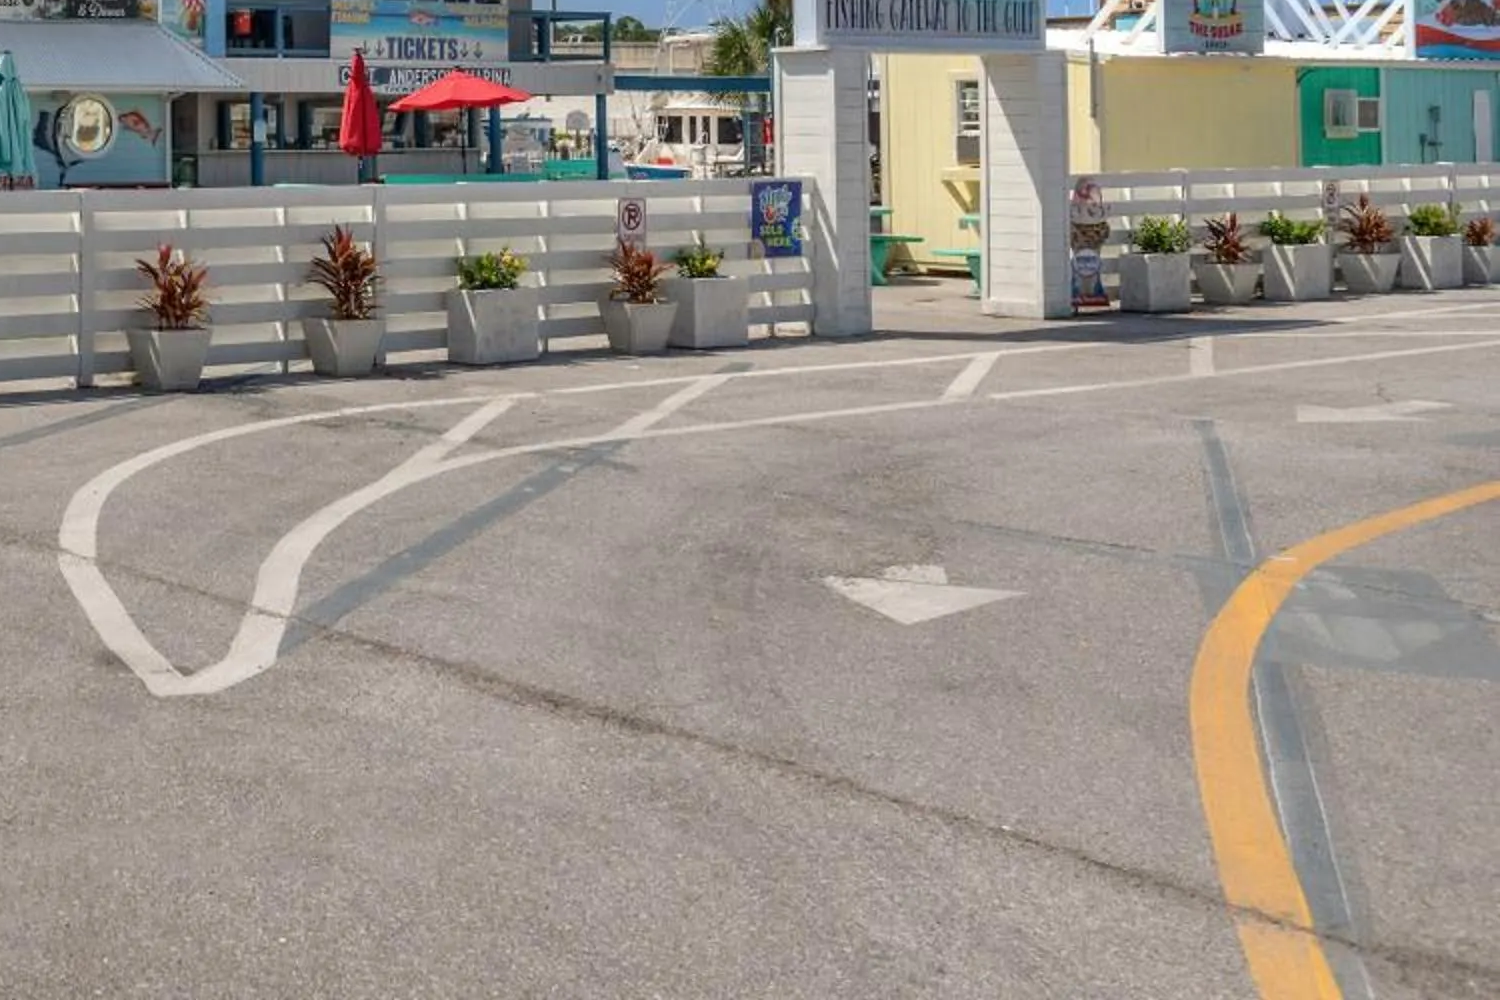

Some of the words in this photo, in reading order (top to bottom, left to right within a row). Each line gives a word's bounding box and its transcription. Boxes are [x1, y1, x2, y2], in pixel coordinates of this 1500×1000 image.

[957, 0, 971, 32] TO
[976, 0, 997, 33] THE
[1003, 0, 1035, 34] GULF
[385, 37, 458, 60] TICKETS
